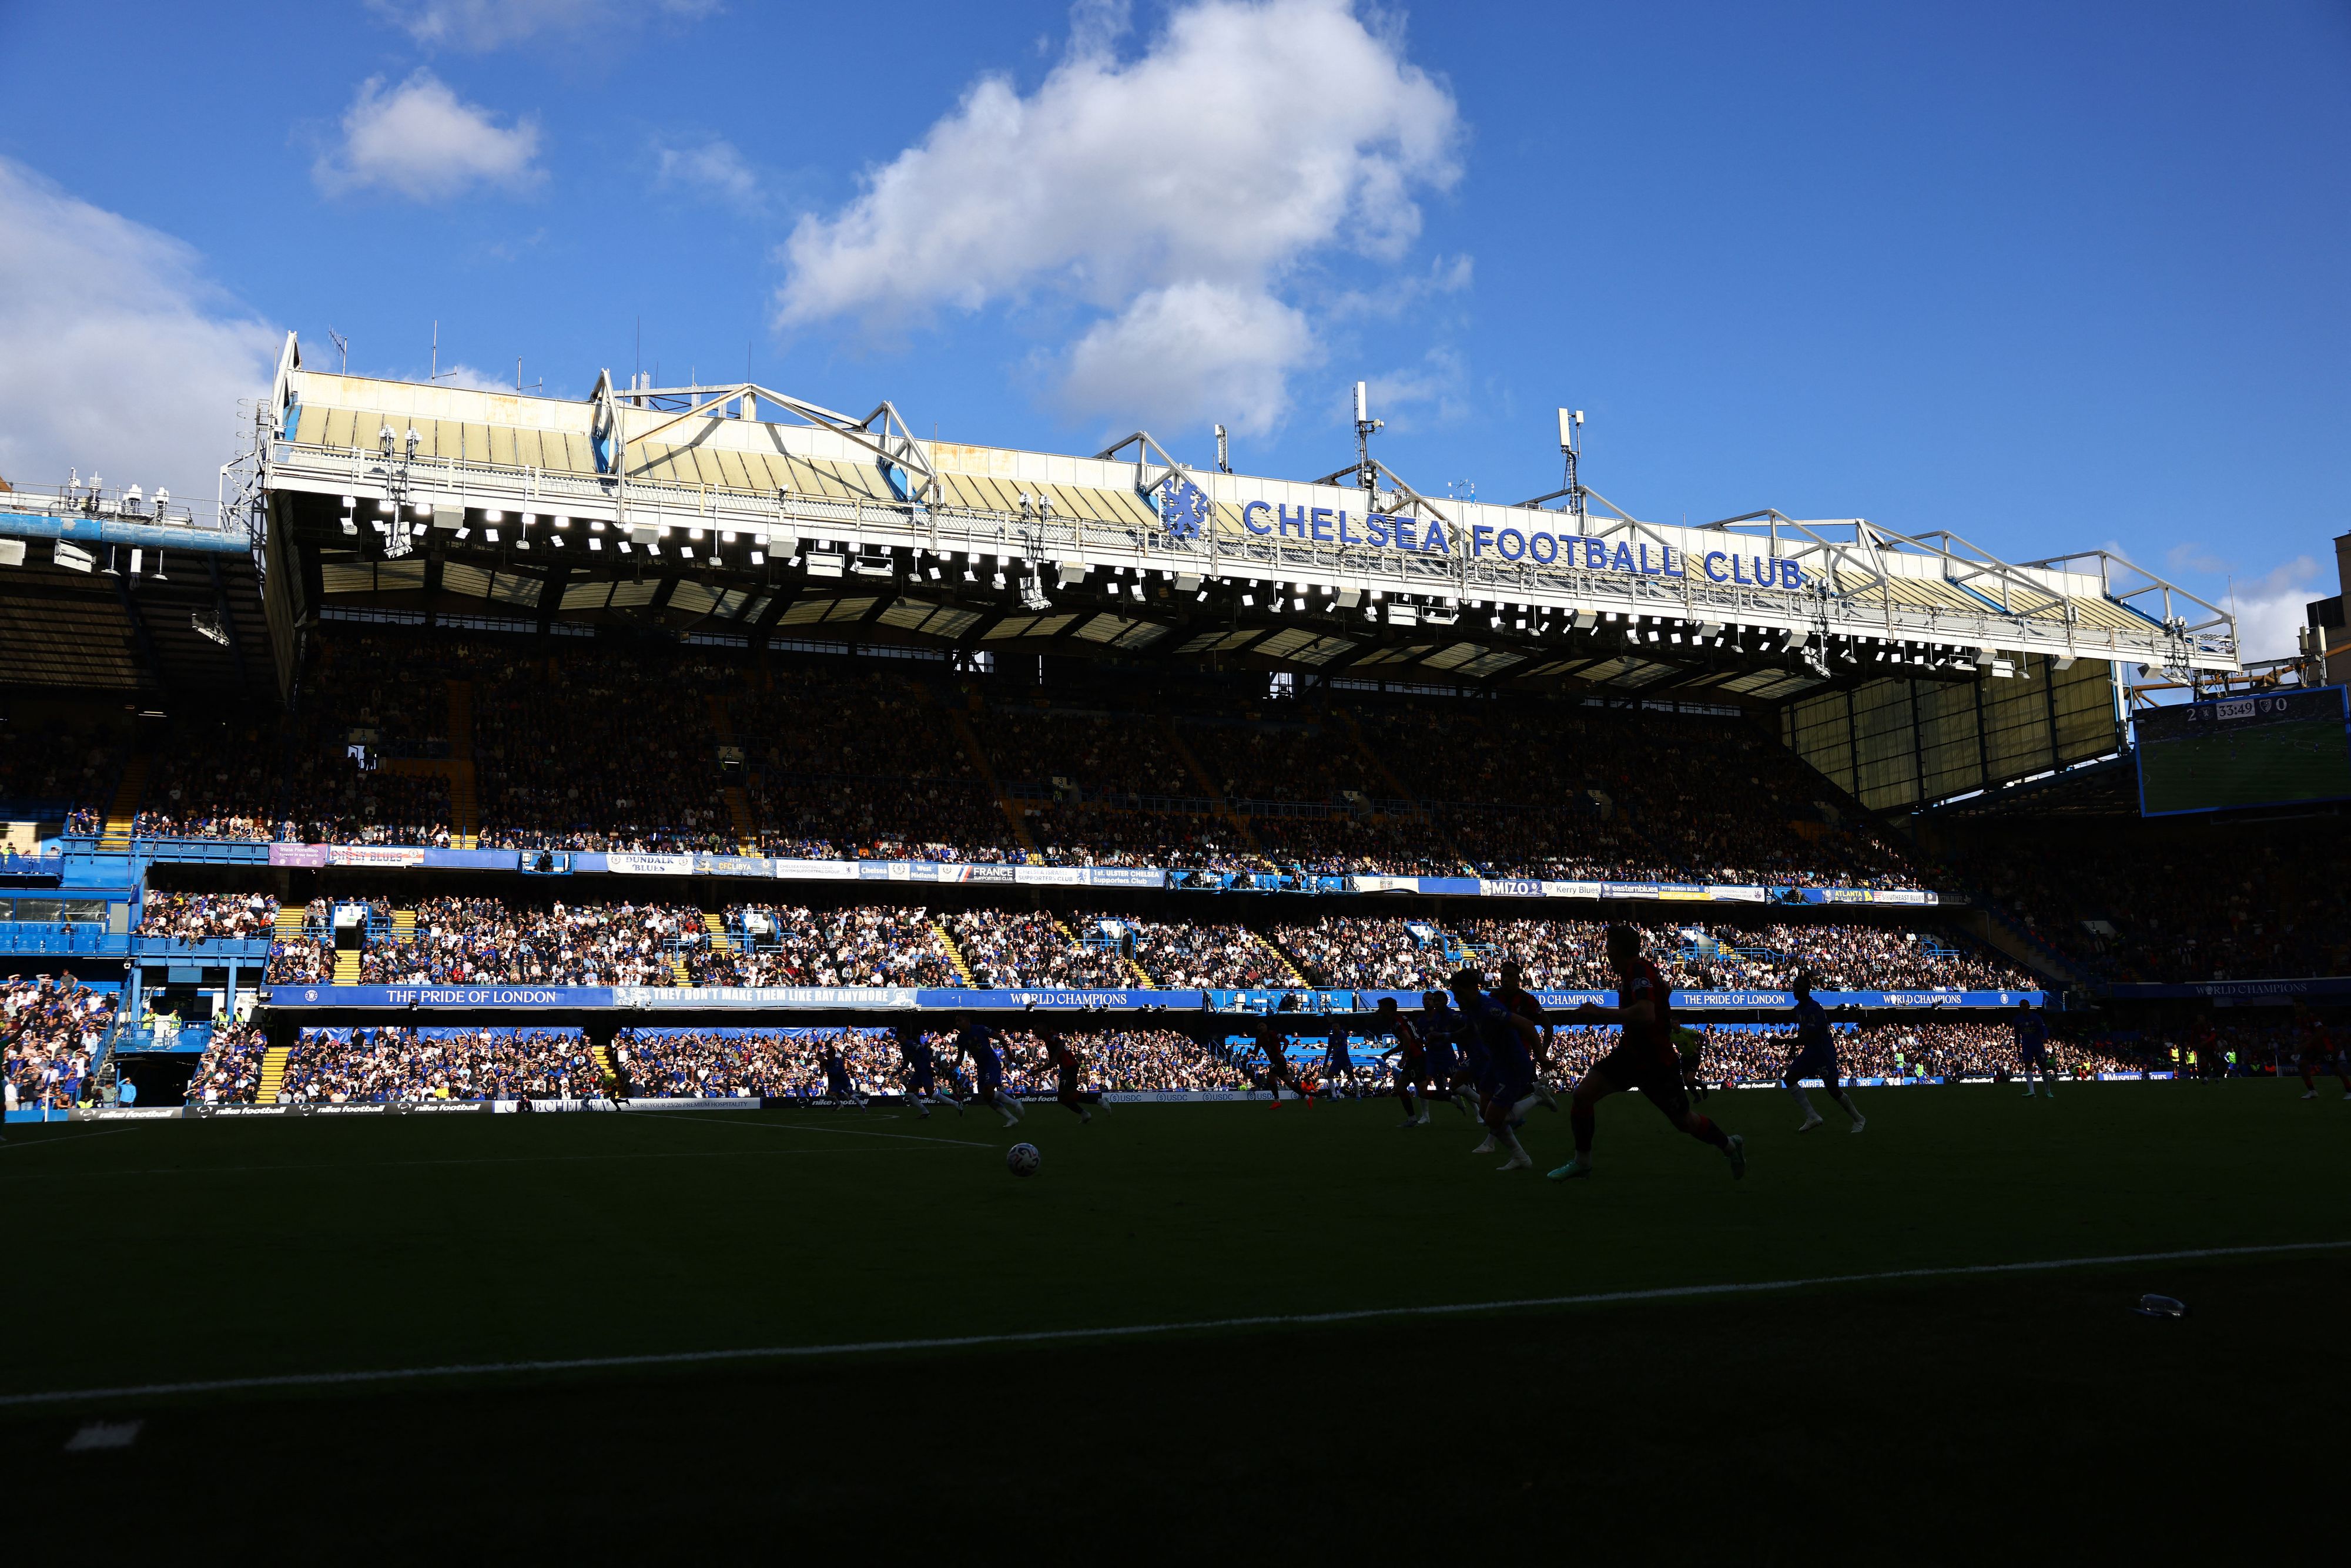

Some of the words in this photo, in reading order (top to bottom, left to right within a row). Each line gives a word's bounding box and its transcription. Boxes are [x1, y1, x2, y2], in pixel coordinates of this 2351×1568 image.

[1243, 500, 1451, 554] CHELSEA
[1473, 523, 1685, 578] FOOTBALL
[1703, 549, 1803, 590] CLUB
[2219, 702, 2253, 717] 33:49
[2276, 698, 2288, 711] 0
[2186, 708, 2197, 722] 2
[370, 852, 402, 862] BLUES
[625, 856, 674, 864] DUNDALK
[632, 863, 665, 872] BLUES
[861, 866, 888, 875] Chelsea
[973, 867, 1013, 876] FRANCE
[1093, 876, 1130, 885] Supporters
[1492, 882, 1528, 895] MIZO
[1556, 886, 1577, 894] Kerry
[1612, 884, 1659, 893] easternblues
[753, 915, 759, 923] 2
[2238, 983, 2308, 994] CHAMPIONS
[386, 990, 418, 1003] THE
[420, 990, 465, 1003] PRIDE
[468, 990, 490, 1003] OF
[493, 990, 556, 1004] LONDON
[653, 988, 682, 1000] THEY
[684, 989, 718, 1001] DON'T
[722, 989, 752, 1001] MAKE
[755, 989, 786, 1002] THEM
[788, 989, 812, 1002] LIKE
[814, 989, 835, 1002] RAY
[837, 989, 888, 1002] ANYMORE
[1056, 993, 1127, 1005] CHAMPIONS
[1547, 994, 1604, 1005] CHAMPIONS
[1683, 994, 1703, 1005] THE
[1703, 994, 1730, 1005] PRIDE
[1732, 994, 1746, 1005] OF
[1747, 994, 1786, 1005] LONDON
[1913, 994, 1962, 1004] CHAMPIONS
[1848, 1079, 1872, 1087] MORE
[215, 1107, 239, 1115] nike
[240, 1106, 287, 1115] football
[340, 1105, 385, 1114] football
[414, 1105, 436, 1113] nike
[437, 1103, 481, 1113] football
[544, 1100, 607, 1113] CHELSEA
[99, 1111, 124, 1119] nike
[125, 1109, 173, 1118] football
